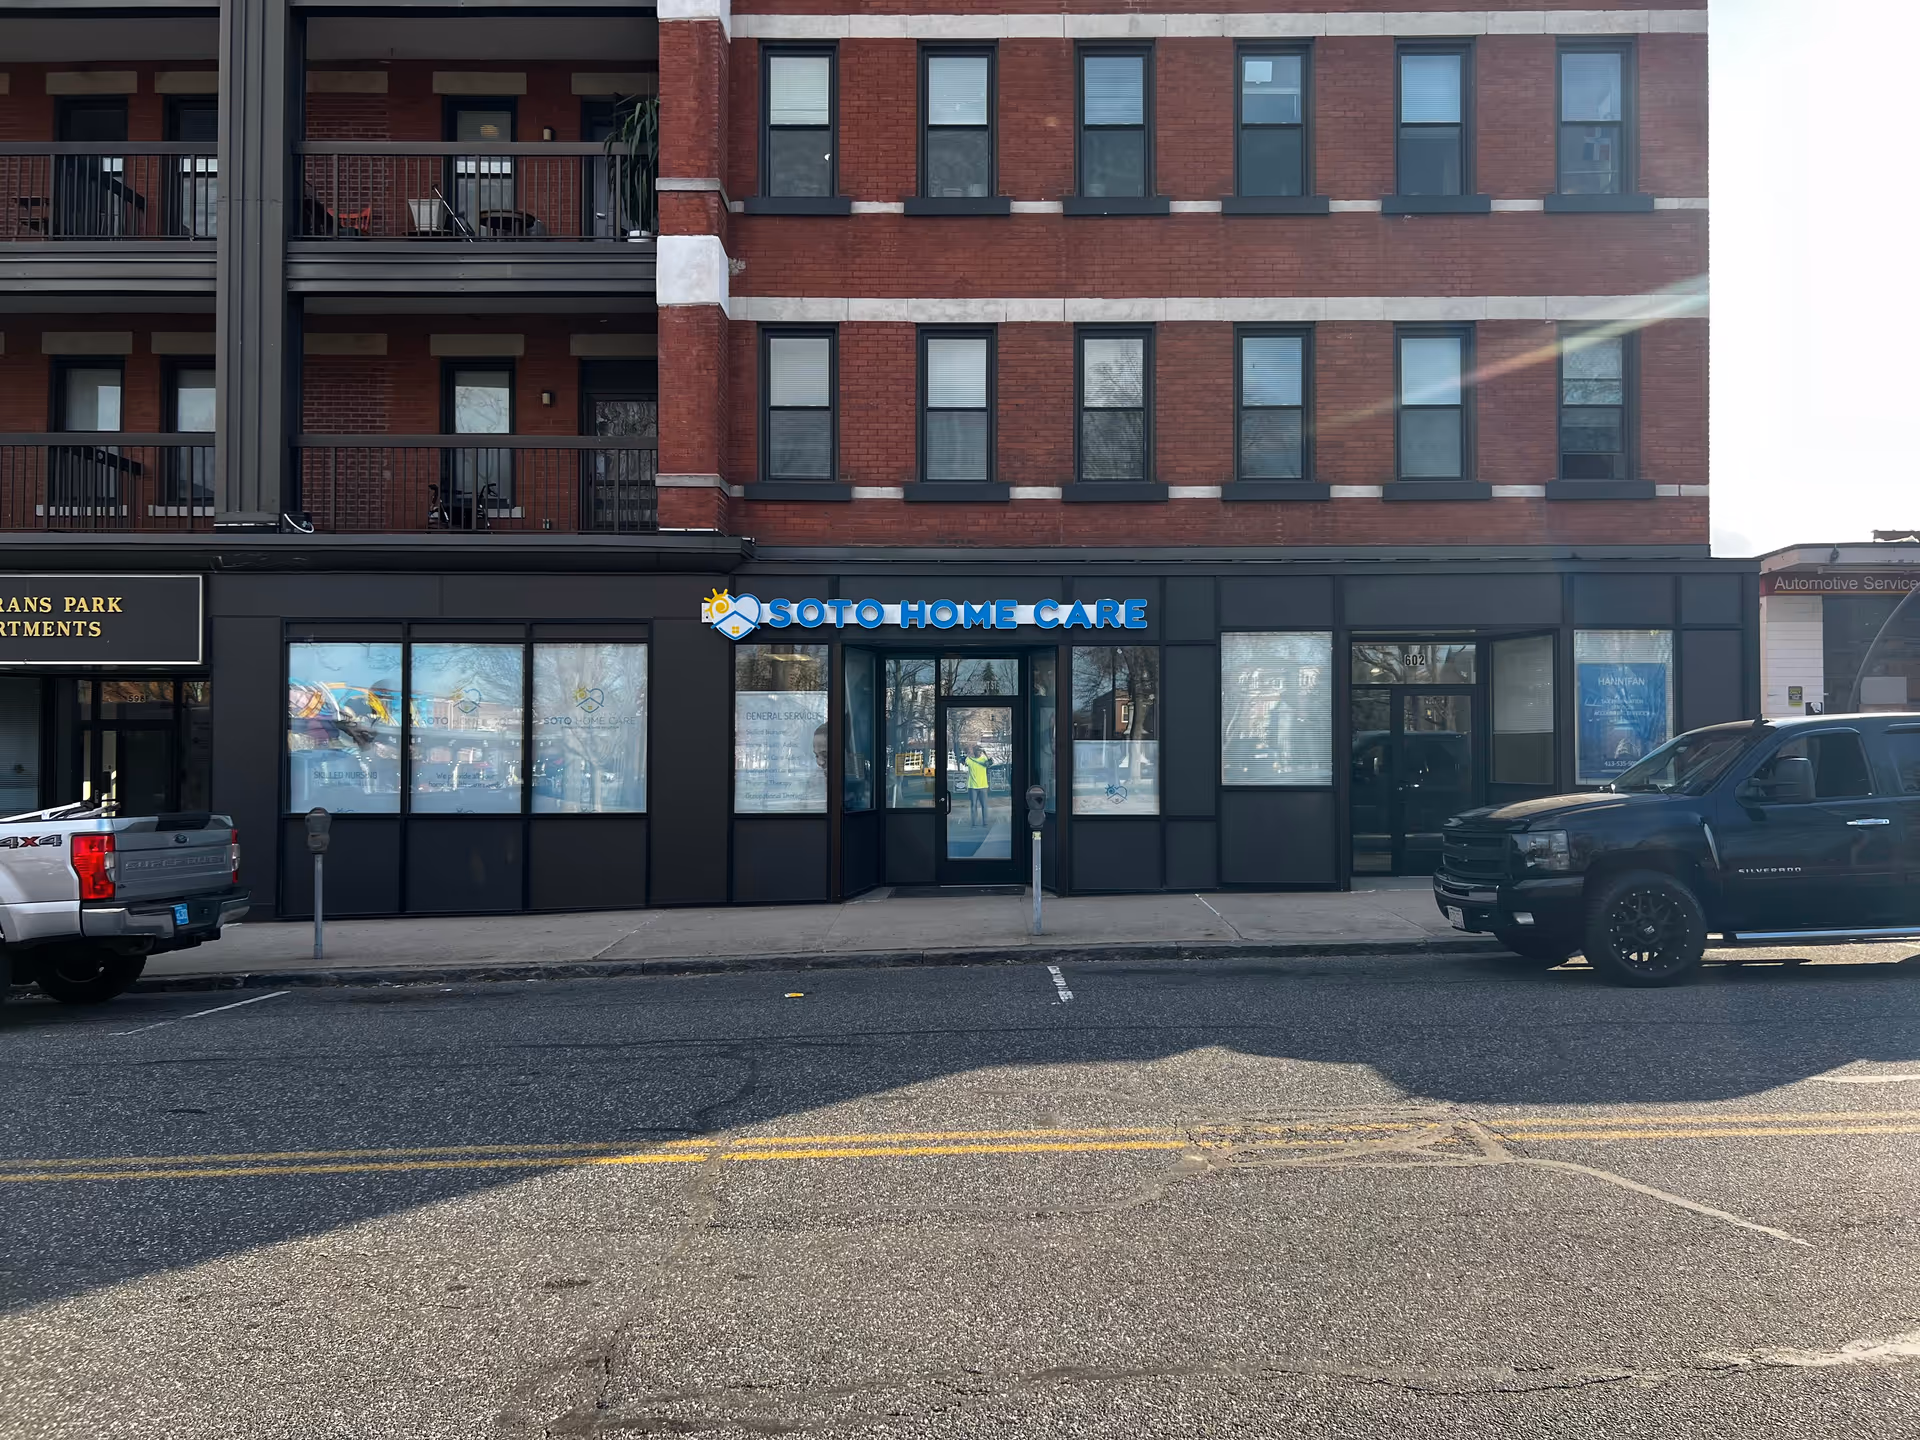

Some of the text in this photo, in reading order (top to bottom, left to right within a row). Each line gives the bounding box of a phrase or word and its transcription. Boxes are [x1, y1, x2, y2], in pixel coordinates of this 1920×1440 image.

[1774, 575, 1858, 590] Automotive
[63, 596, 123, 613] PARK
[768, 597, 1148, 629] SOTO HOME CARE
[1405, 654, 1425, 666] 602
[1598, 677, 1645, 686] HANNIFAN
[543, 716, 572, 725] SOTO
[608, 716, 636, 725] CARE
[746, 711, 783, 721] GENERAL
[345, 771, 378, 780] NURSNG
[1738, 866, 1802, 874] SILVERADO
